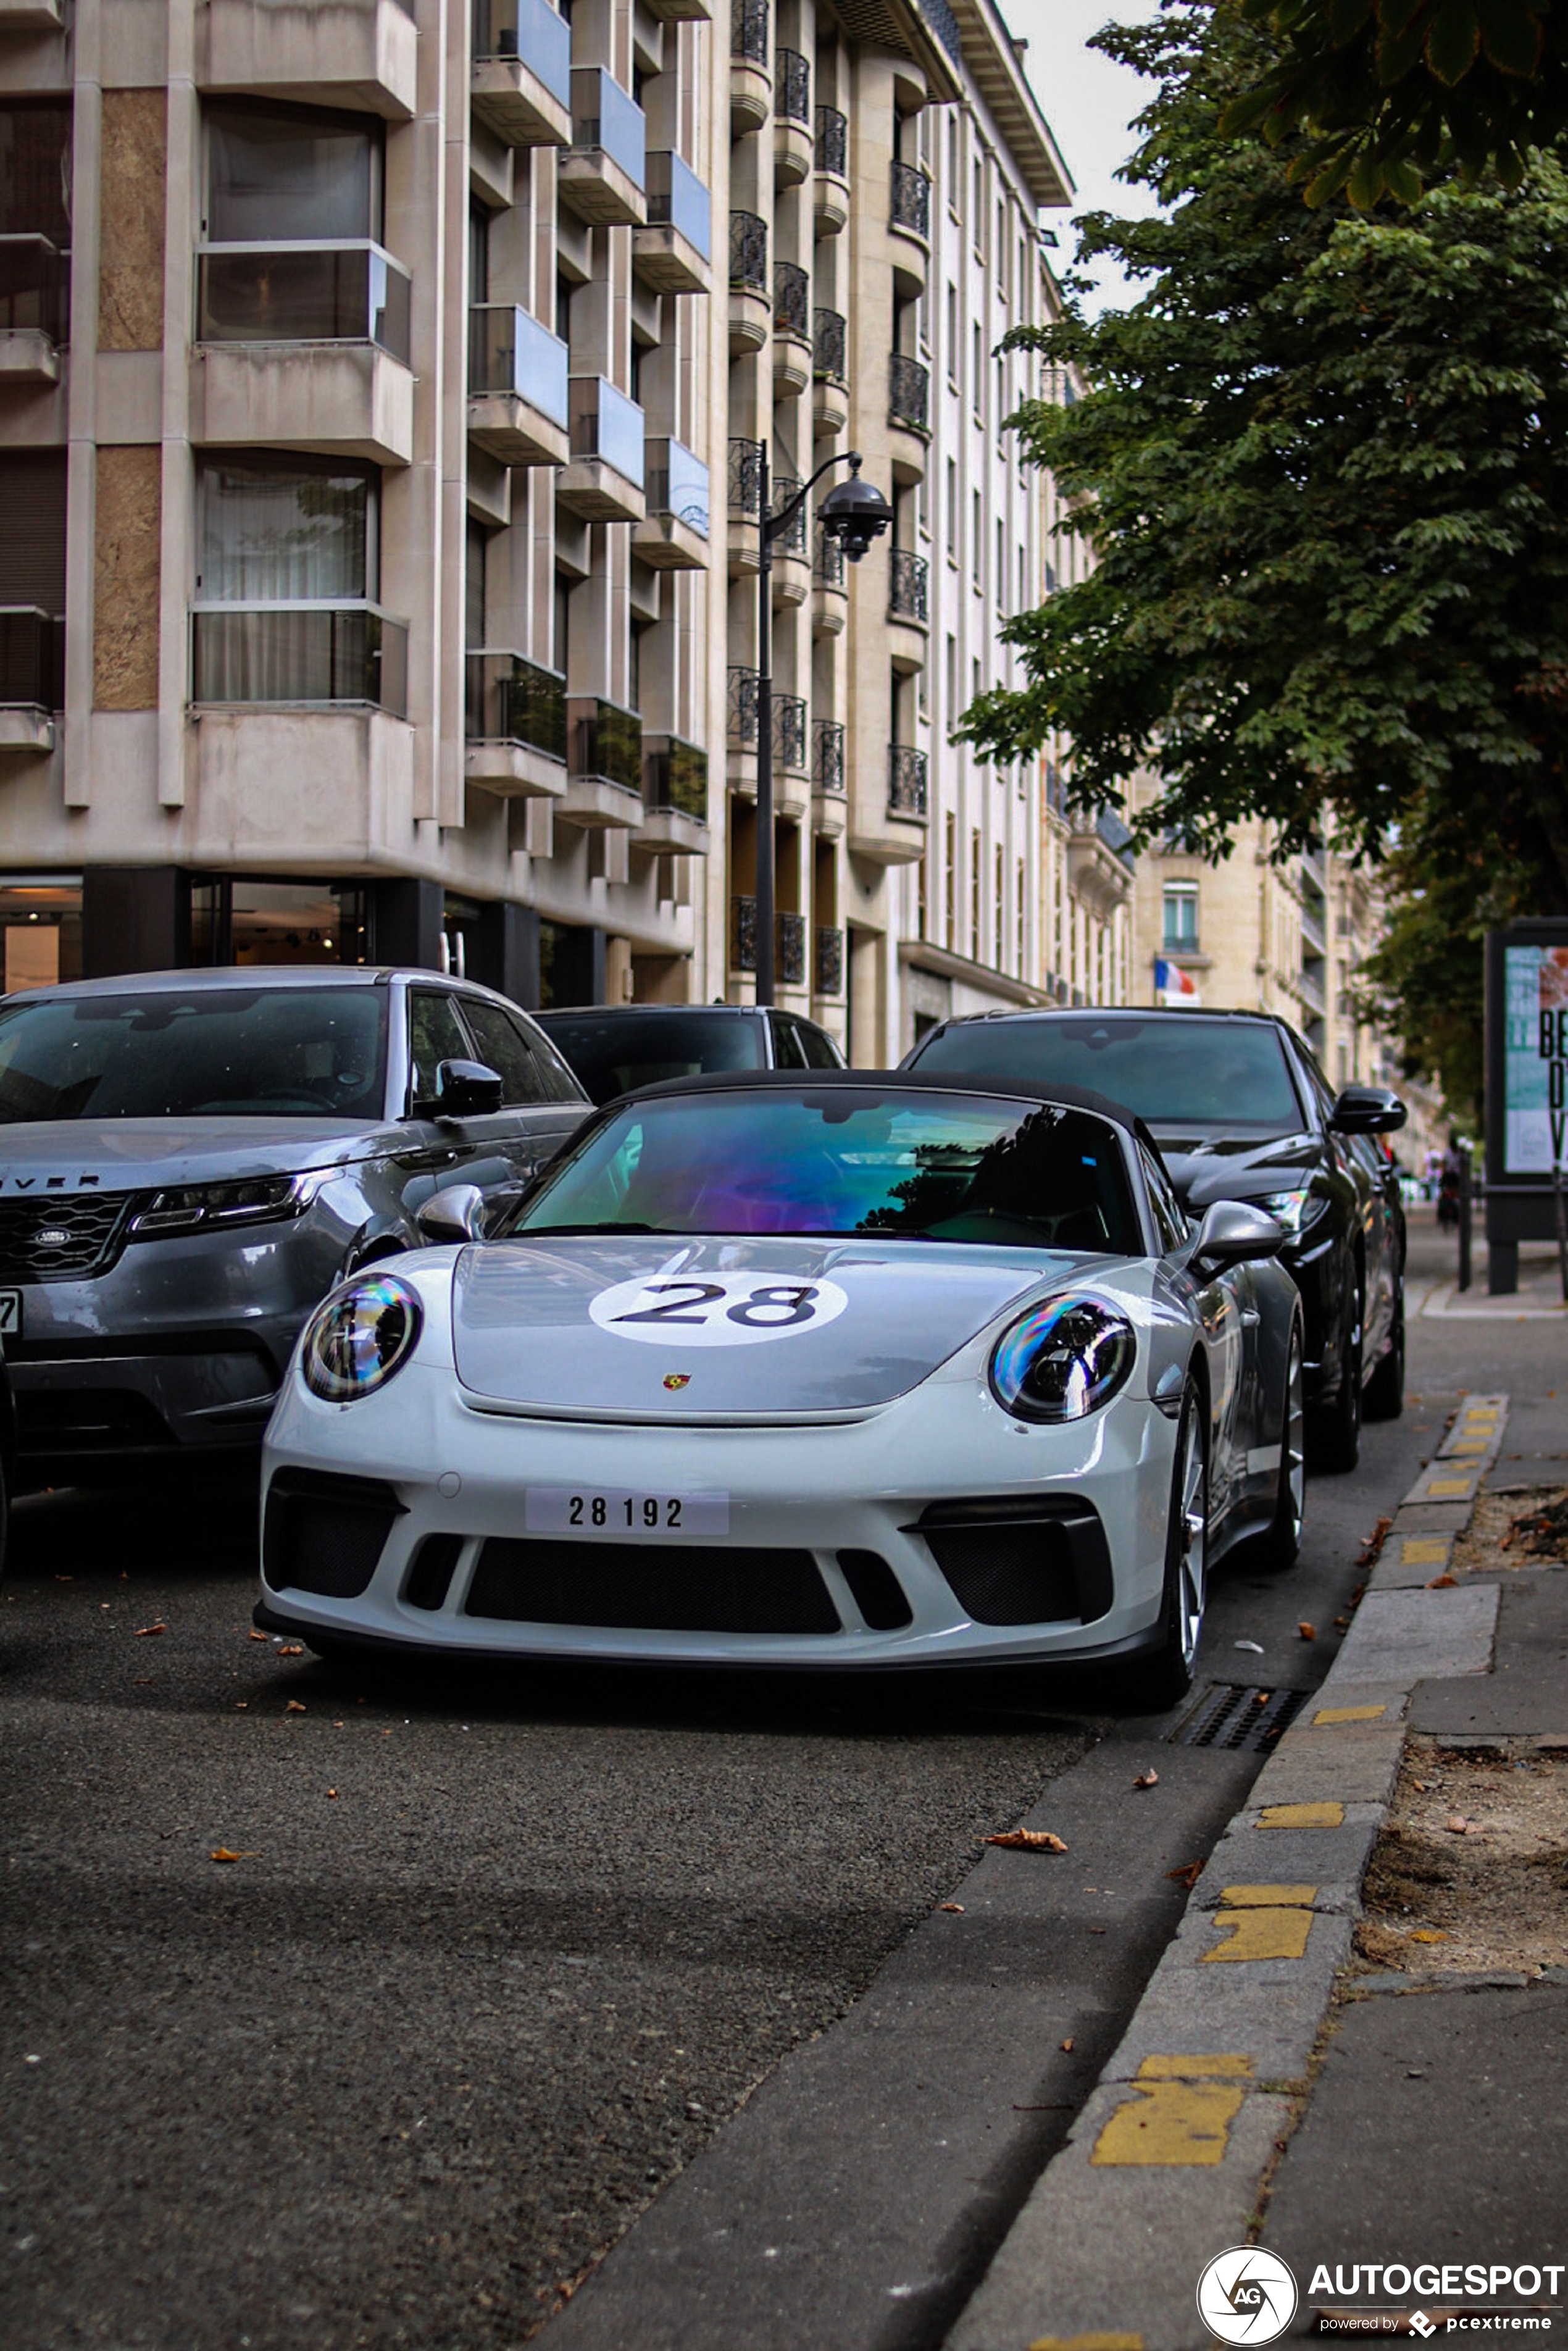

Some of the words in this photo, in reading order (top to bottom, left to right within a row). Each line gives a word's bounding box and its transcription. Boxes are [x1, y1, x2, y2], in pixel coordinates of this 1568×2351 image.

[1549, 1062, 1568, 1109] D
[1550, 1112, 1568, 1160] V
[0, 1176, 99, 1189] VER
[607, 1283, 819, 1327] 28
[569, 1497, 606, 1526] 28
[623, 1498, 682, 1527] 192
